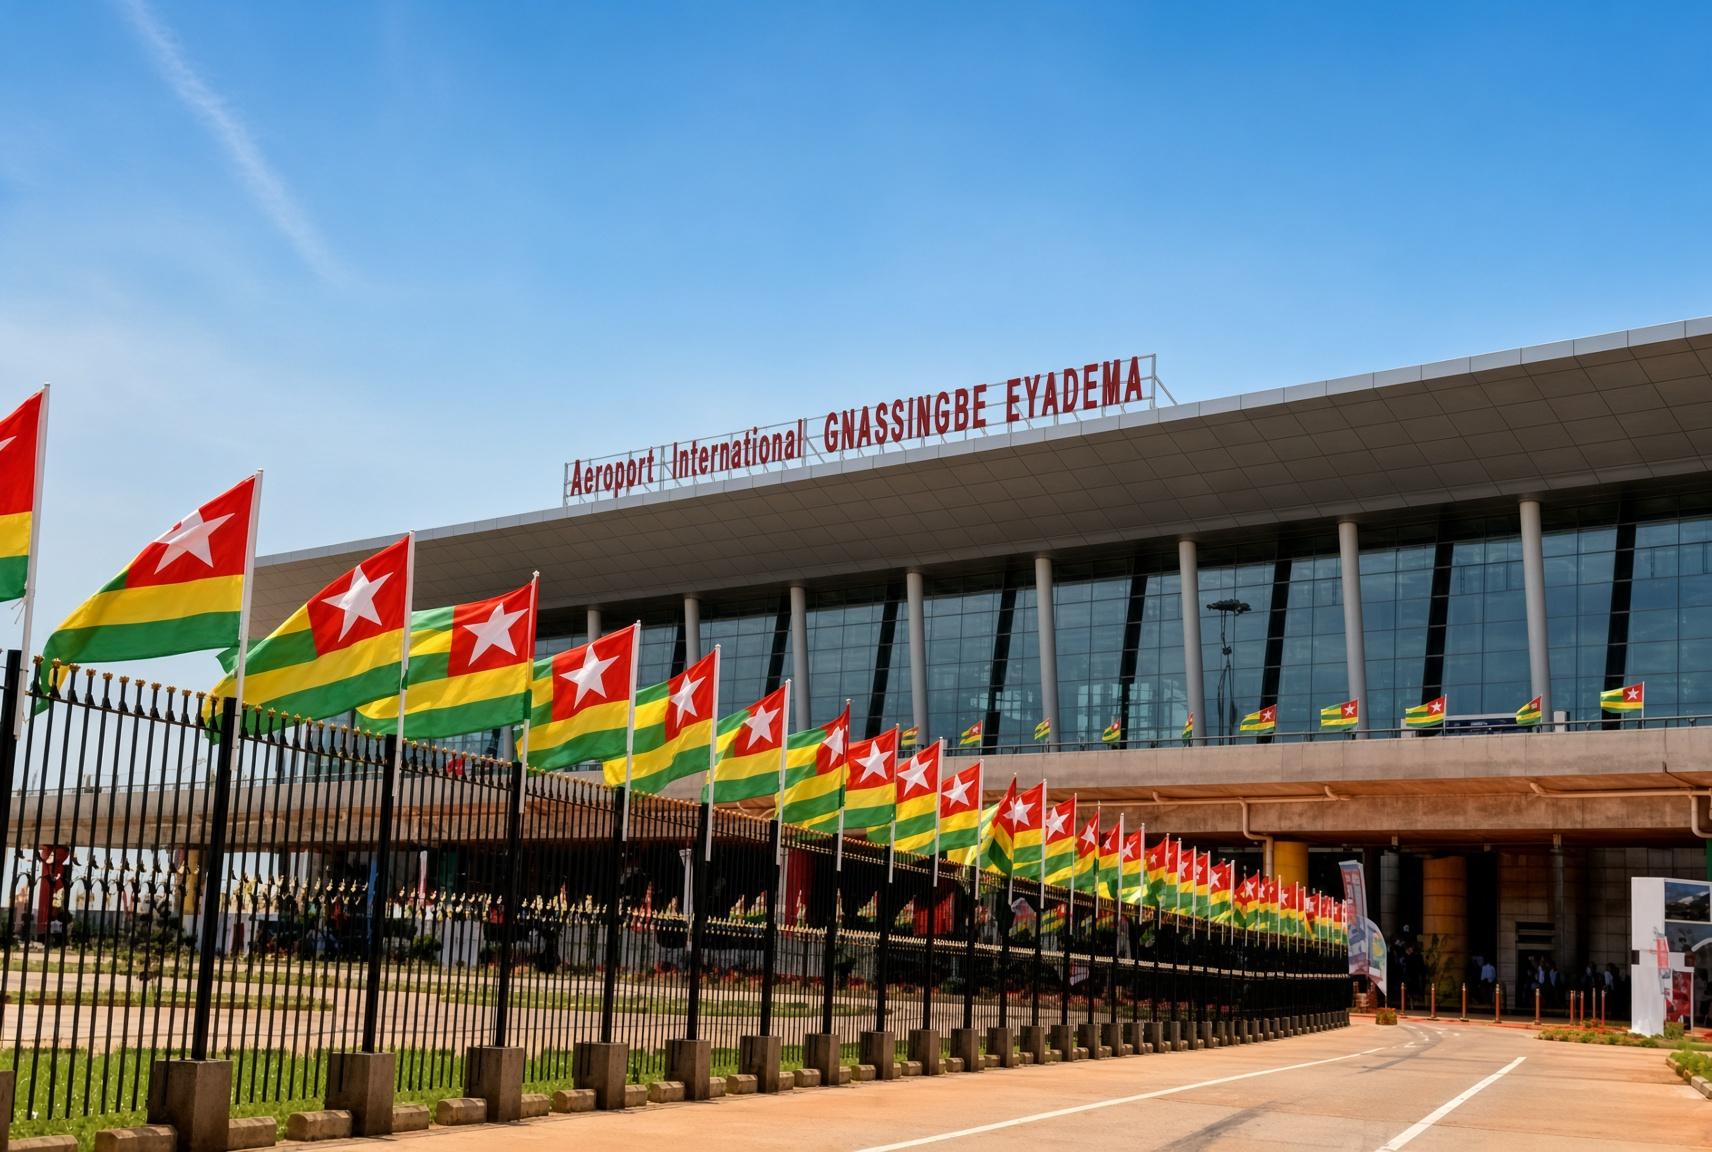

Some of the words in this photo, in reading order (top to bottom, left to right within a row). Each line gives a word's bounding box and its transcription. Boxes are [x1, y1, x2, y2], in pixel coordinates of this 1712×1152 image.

[570, 446, 655, 498] Aeroport
[672, 418, 803, 480] International
[823, 383, 987, 453] GNASSINGBE
[1006, 356, 1143, 423] EYADEMA
